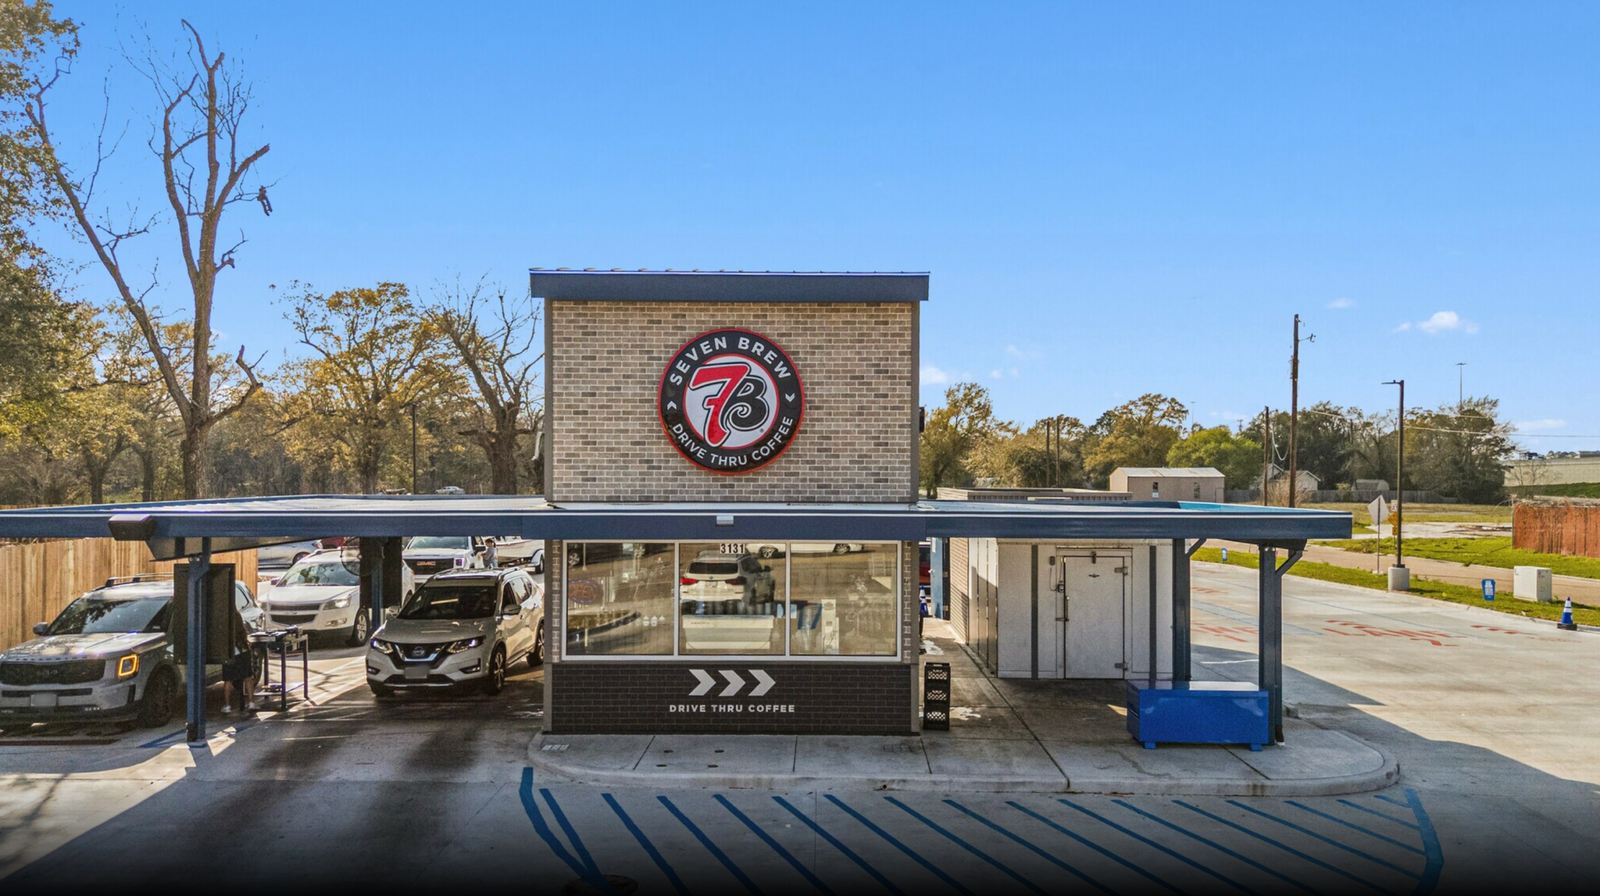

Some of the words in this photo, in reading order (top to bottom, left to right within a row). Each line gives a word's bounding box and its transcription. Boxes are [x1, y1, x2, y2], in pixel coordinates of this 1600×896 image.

[670, 337, 727, 386] SEVEN
[738, 337, 791, 380] BREW
[672, 423, 707, 460] DRIVE
[710, 453, 747, 467] THRU
[752, 416, 793, 461] COFFEE
[720, 543, 744, 554] 3131
[669, 704, 706, 713] DRIVE
[711, 704, 743, 713] THRU
[748, 704, 795, 713] COFFEE
